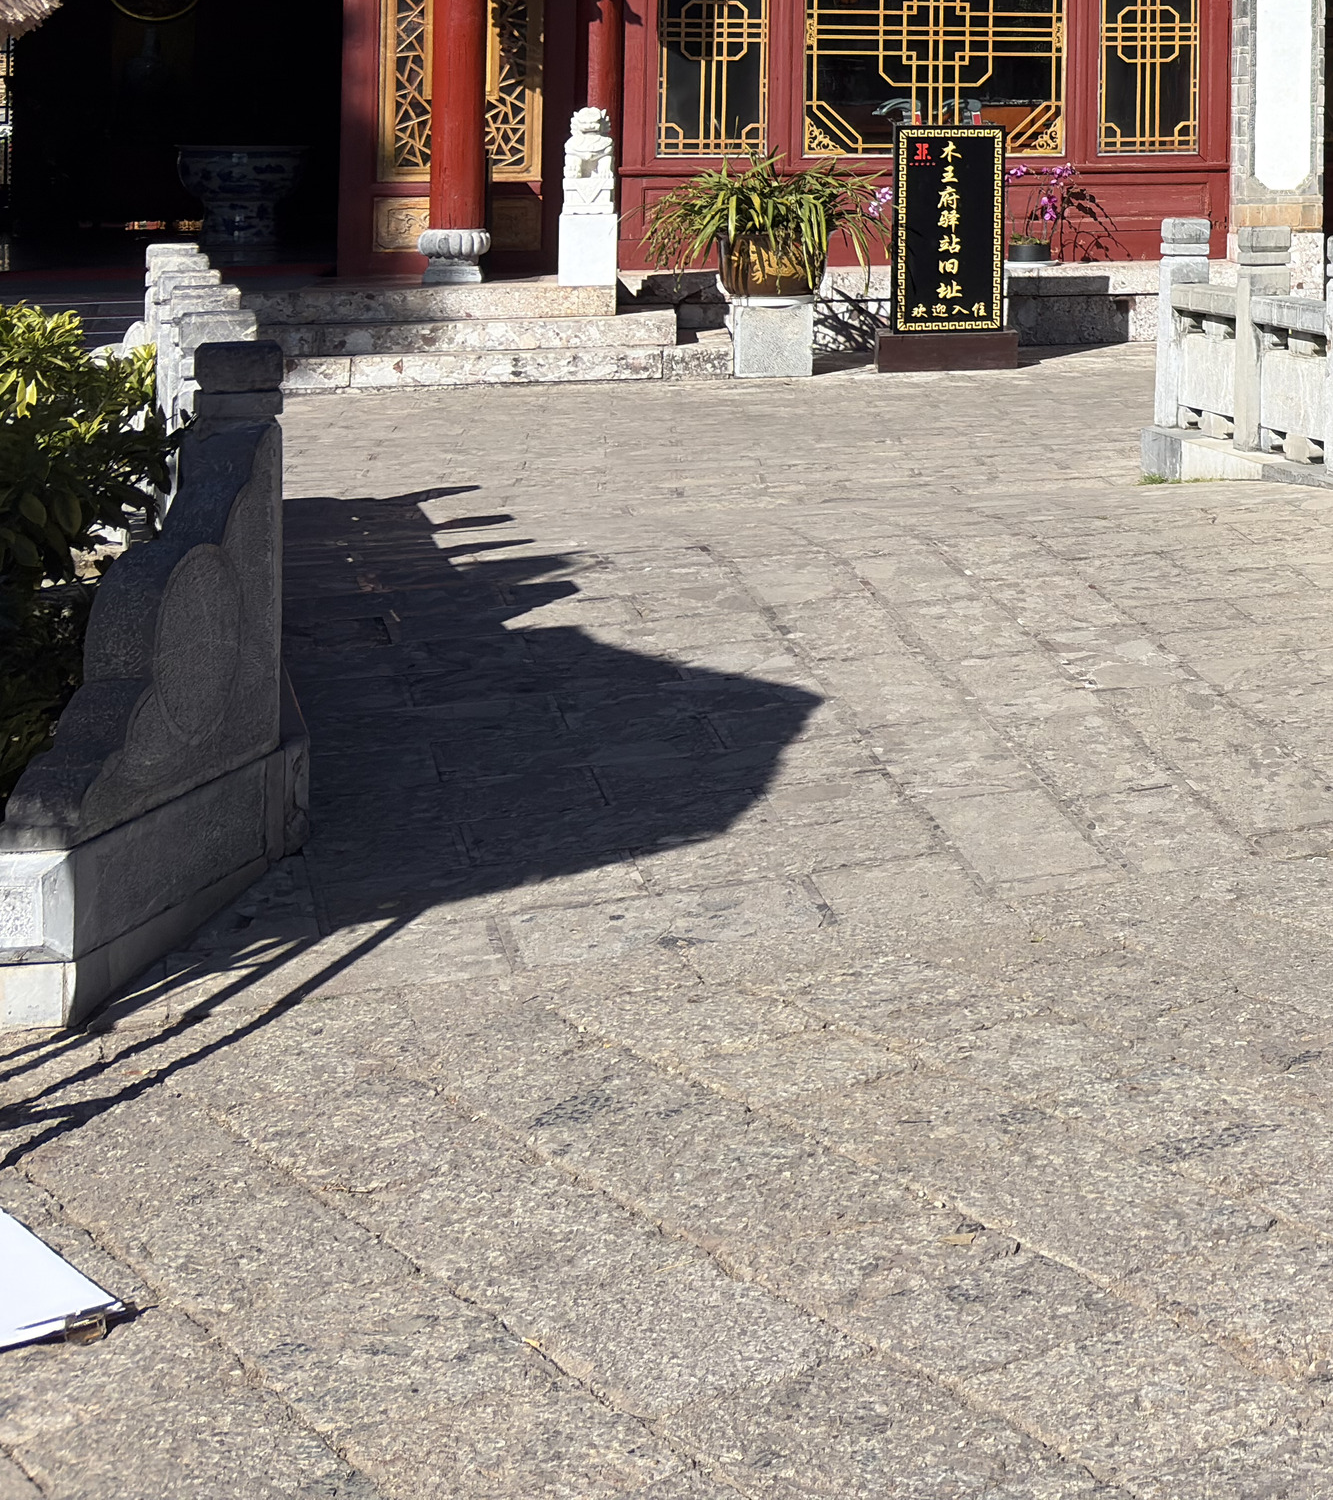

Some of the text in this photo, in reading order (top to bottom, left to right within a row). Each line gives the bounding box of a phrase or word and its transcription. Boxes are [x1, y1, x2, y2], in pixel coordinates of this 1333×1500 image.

[936, 140, 963, 299] 木王府驿站旧址
[911, 301, 988, 318] 欢迎入住
